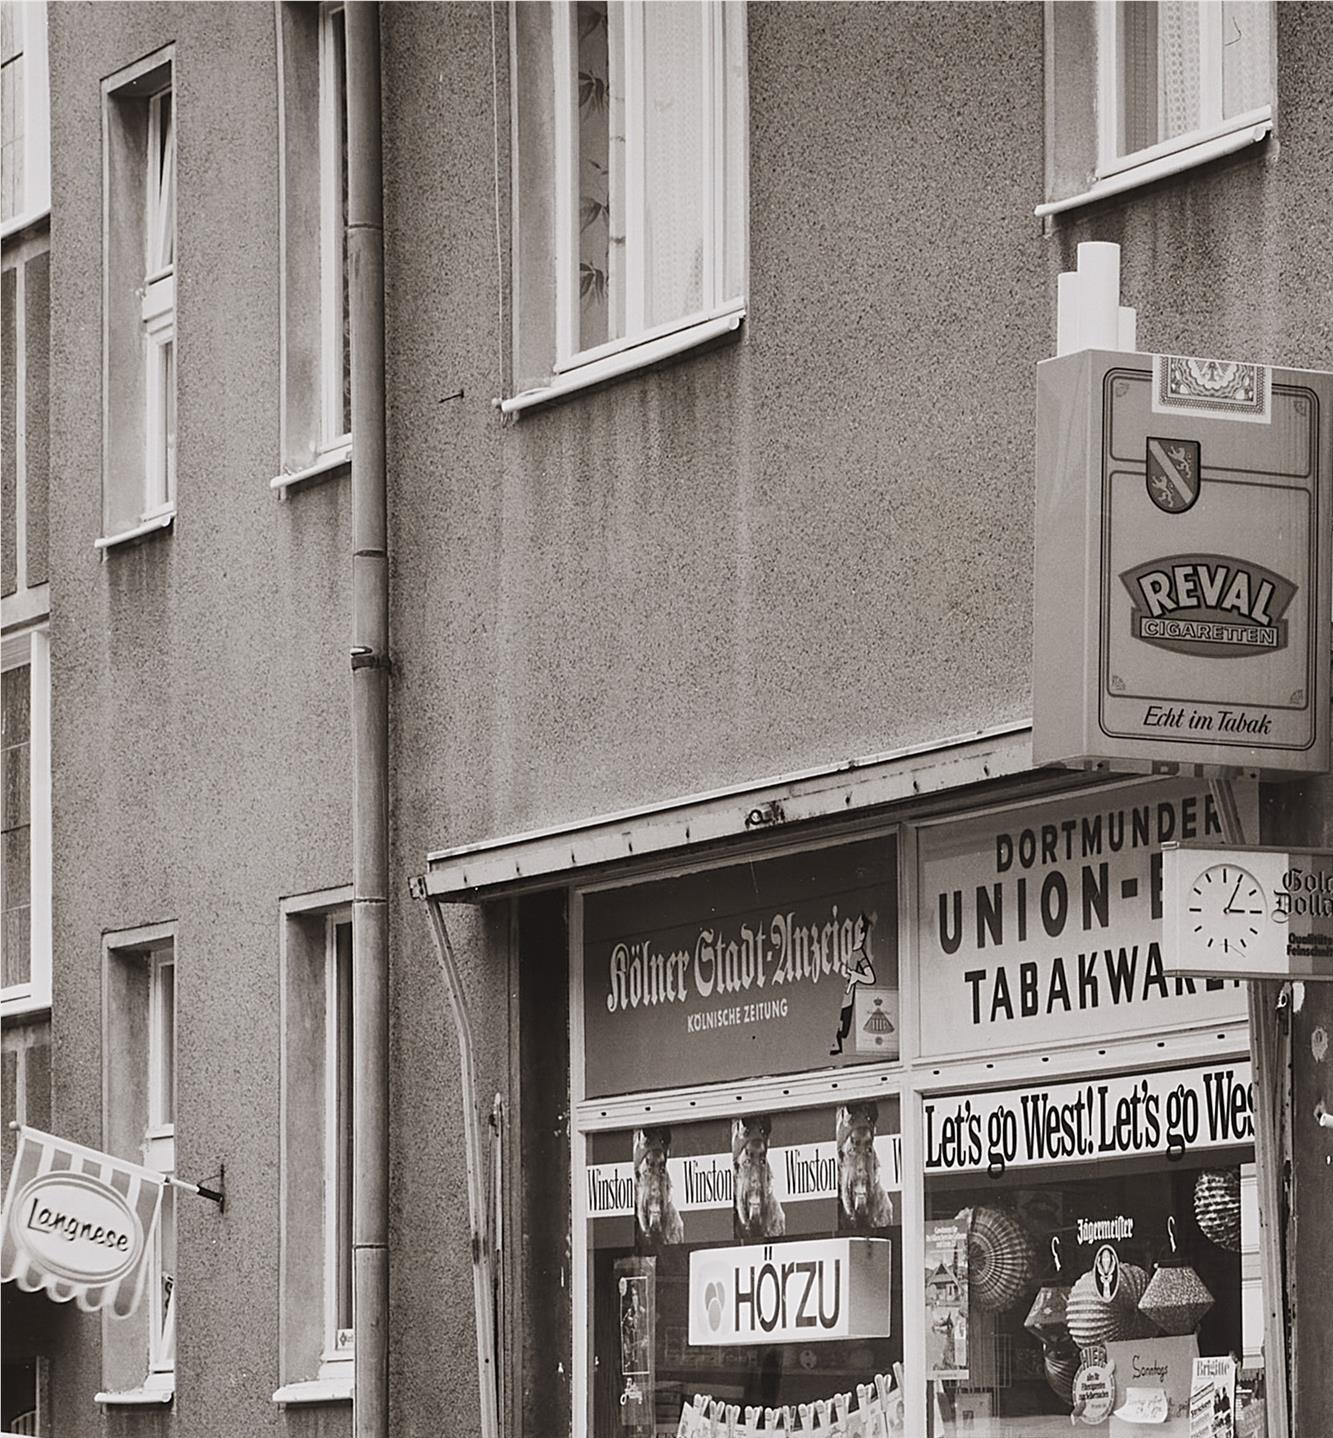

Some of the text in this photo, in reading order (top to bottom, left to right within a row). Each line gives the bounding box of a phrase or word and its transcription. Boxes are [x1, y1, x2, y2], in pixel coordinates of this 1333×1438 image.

[1137, 564, 1275, 626] REVAL
[1143, 620, 1276, 645] CIGARETTEN
[1143, 706, 1272, 735] Echt im Tabak
[996, 795, 1222, 872] DORTMUNDER
[607, 940, 690, 1013] Kölner
[687, 998, 788, 1033] KÖLNISCHE ZEITUNG
[925, 1100, 981, 1167] Let's
[987, 1105, 1017, 1179] go
[1022, 1087, 1093, 1160] West!
[1098, 1080, 1160, 1152] Let's
[1166, 1084, 1198, 1160] go
[587, 1168, 634, 1211] Winston
[683, 1159, 732, 1204] Winston
[784, 1148, 837, 1195] Winston
[28, 1198, 129, 1252] Langnese
[1197, 1359, 1230, 1376] Brigitte
